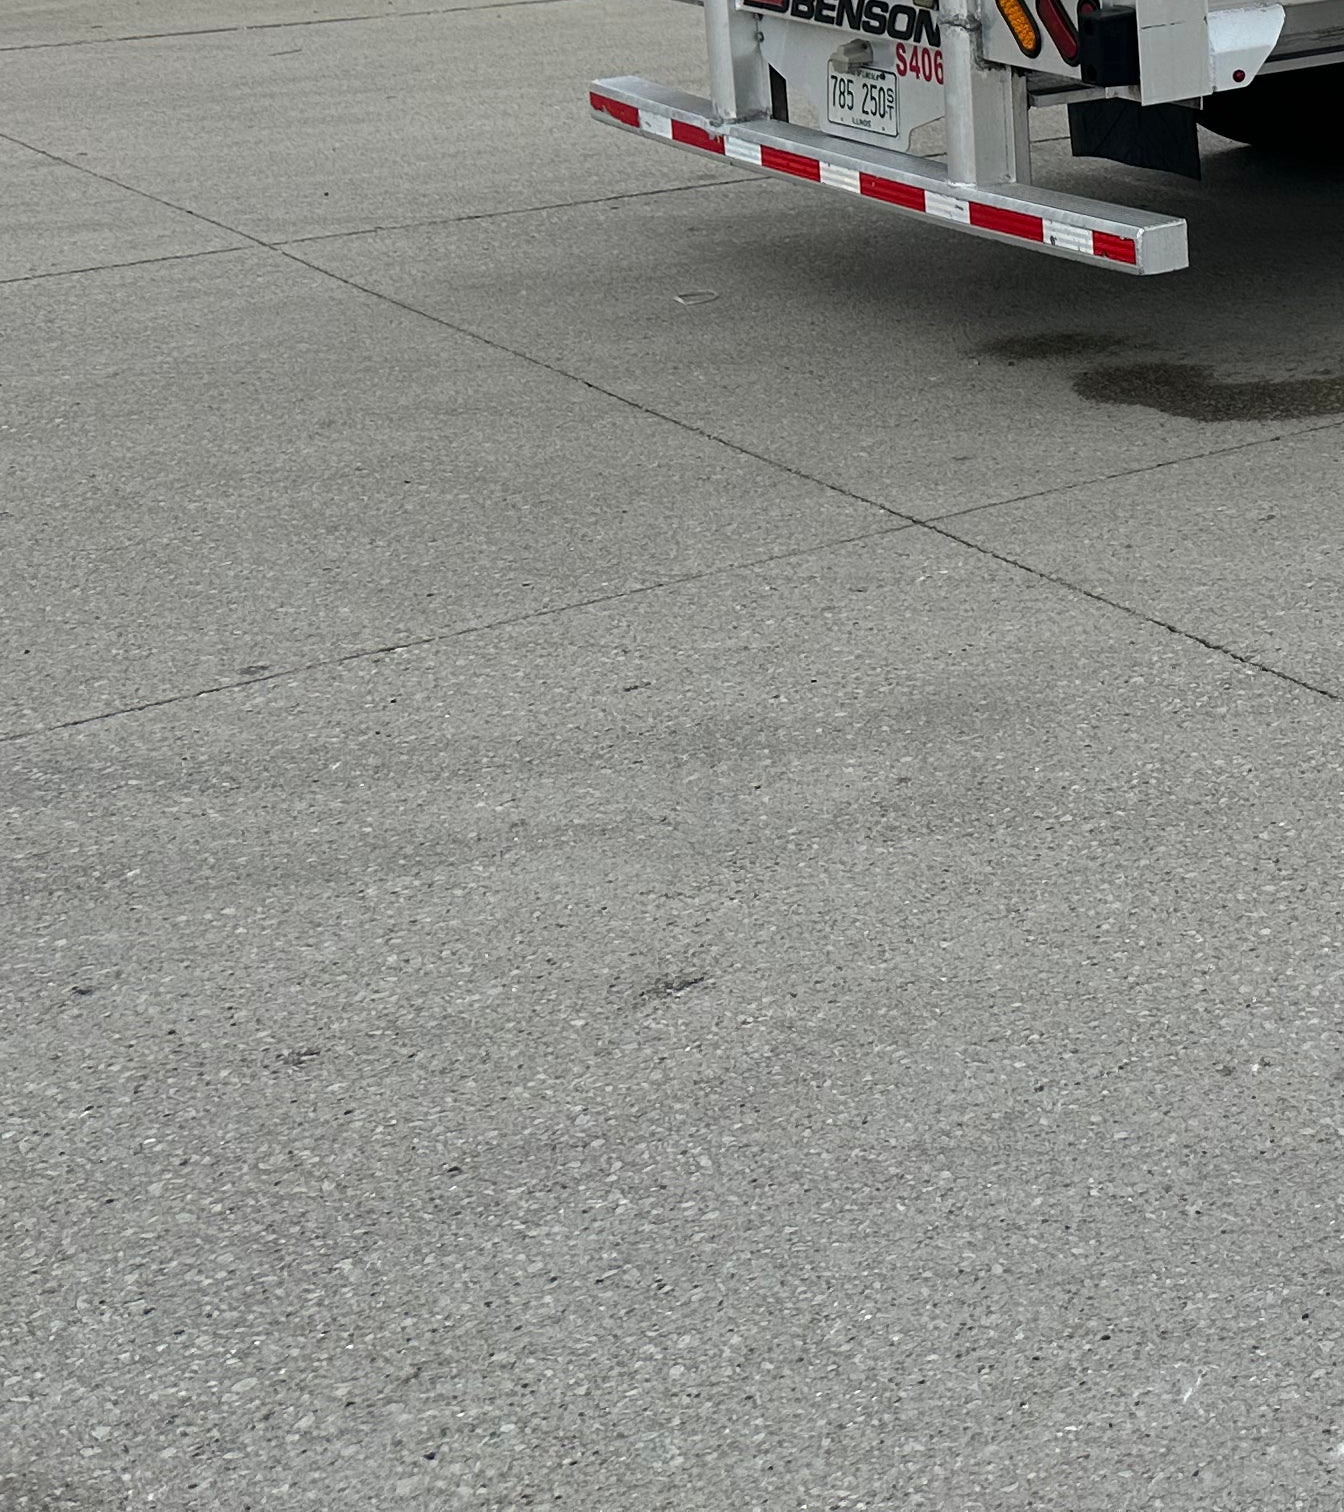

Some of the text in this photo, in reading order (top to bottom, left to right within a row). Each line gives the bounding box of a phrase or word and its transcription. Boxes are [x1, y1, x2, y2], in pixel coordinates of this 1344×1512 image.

[895, 42, 944, 85] S406
[831, 75, 886, 118] 785 250
